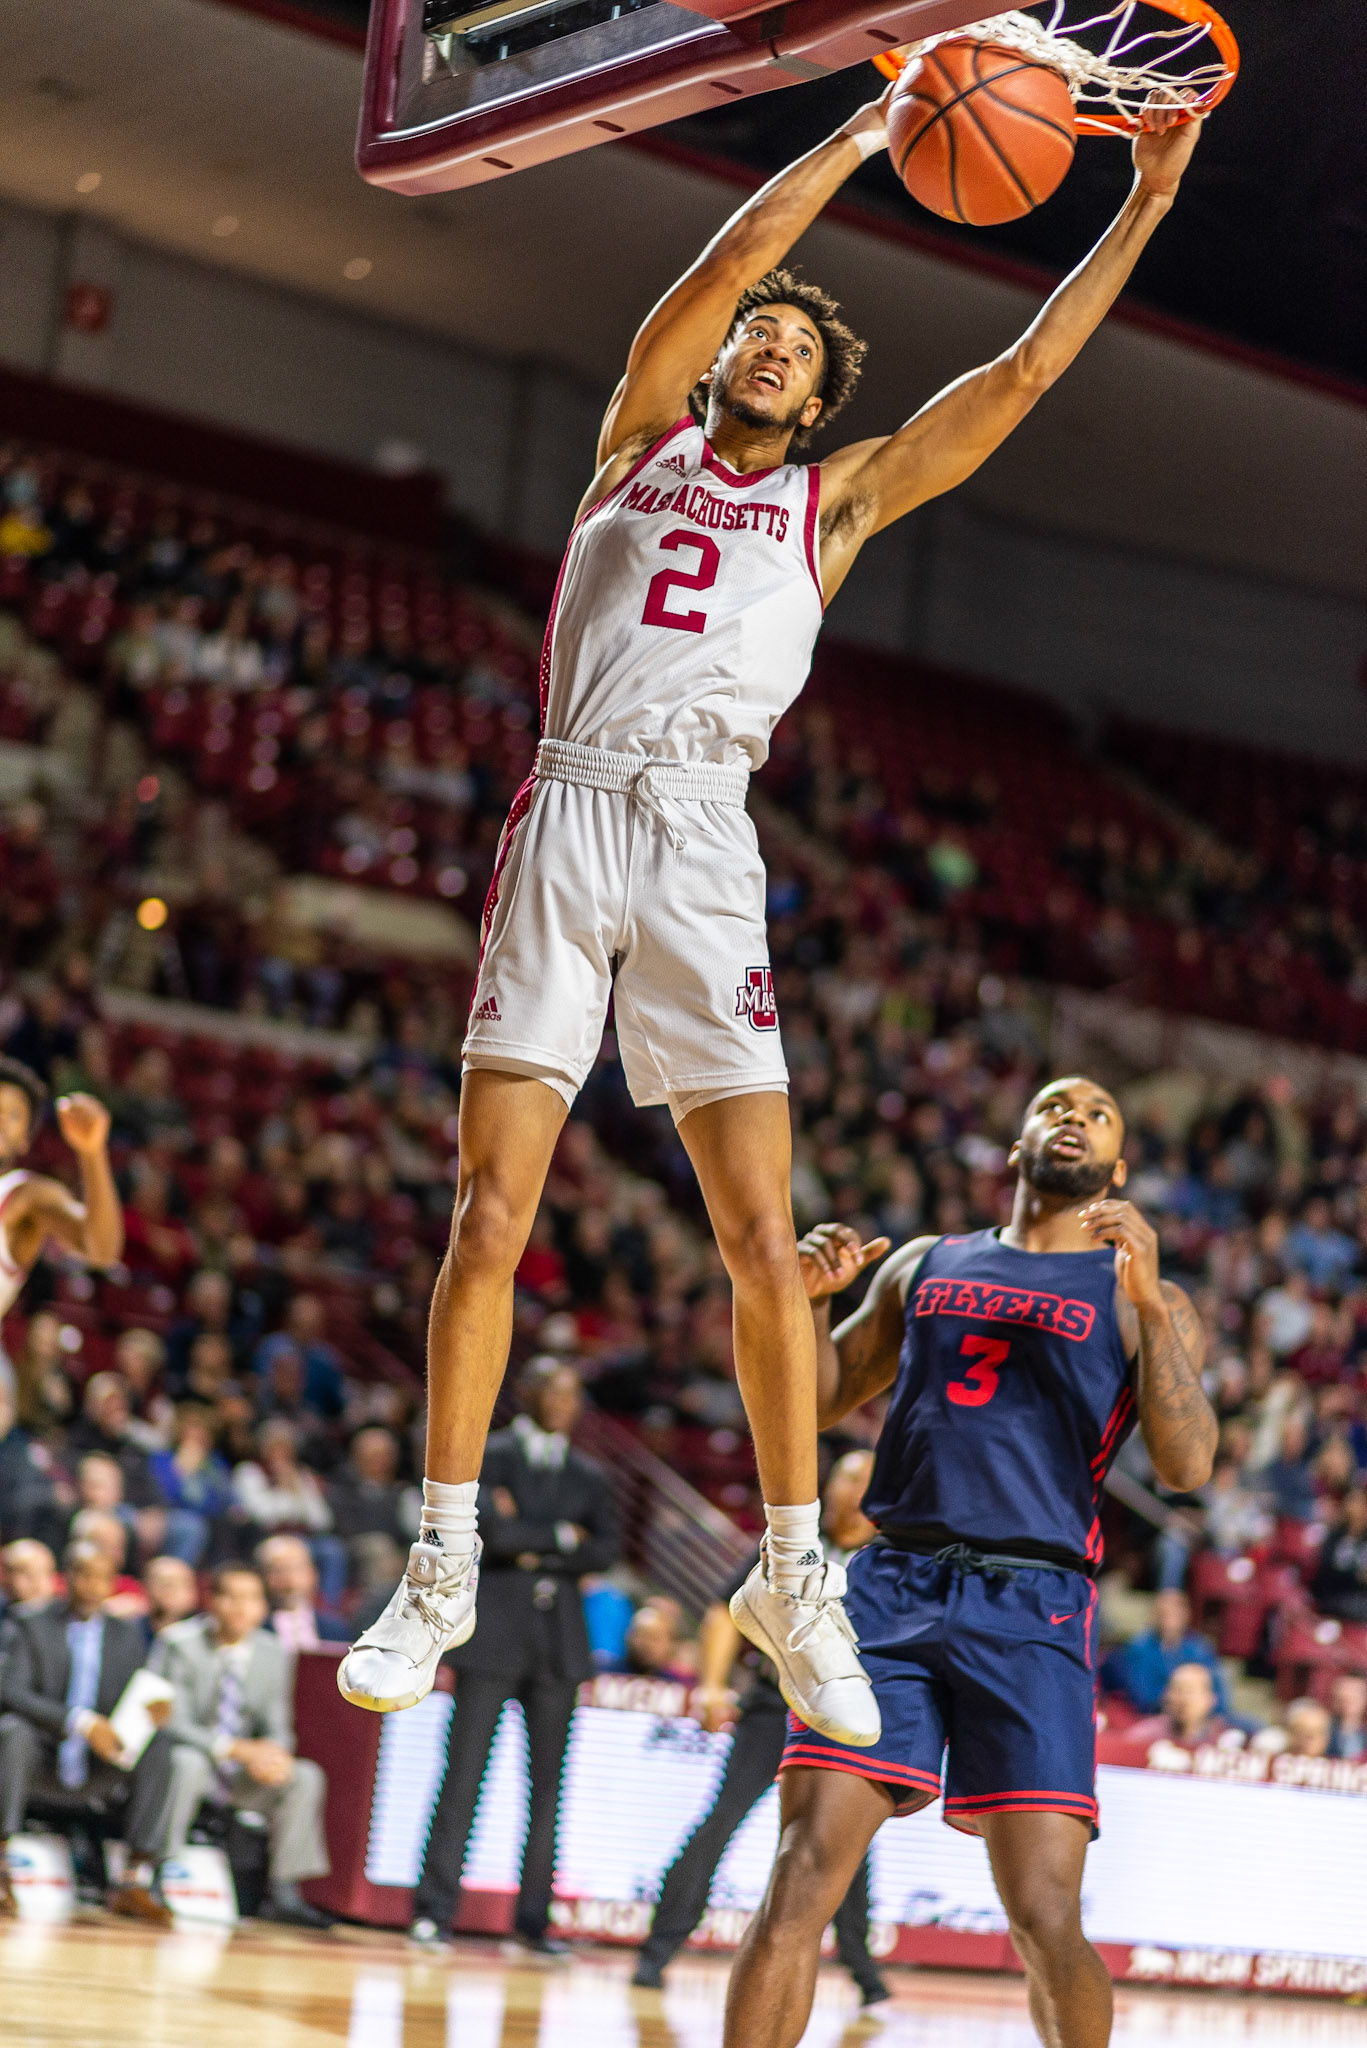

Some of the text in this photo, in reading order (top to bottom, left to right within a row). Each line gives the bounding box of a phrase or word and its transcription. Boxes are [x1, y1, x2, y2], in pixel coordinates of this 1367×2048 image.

[655, 460, 687, 478] adidas
[641, 529, 721, 634] 2
[475, 1009, 502, 1022] adidas
[915, 1278, 1096, 1342] FLYERS
[947, 1334, 1011, 1407] 3
